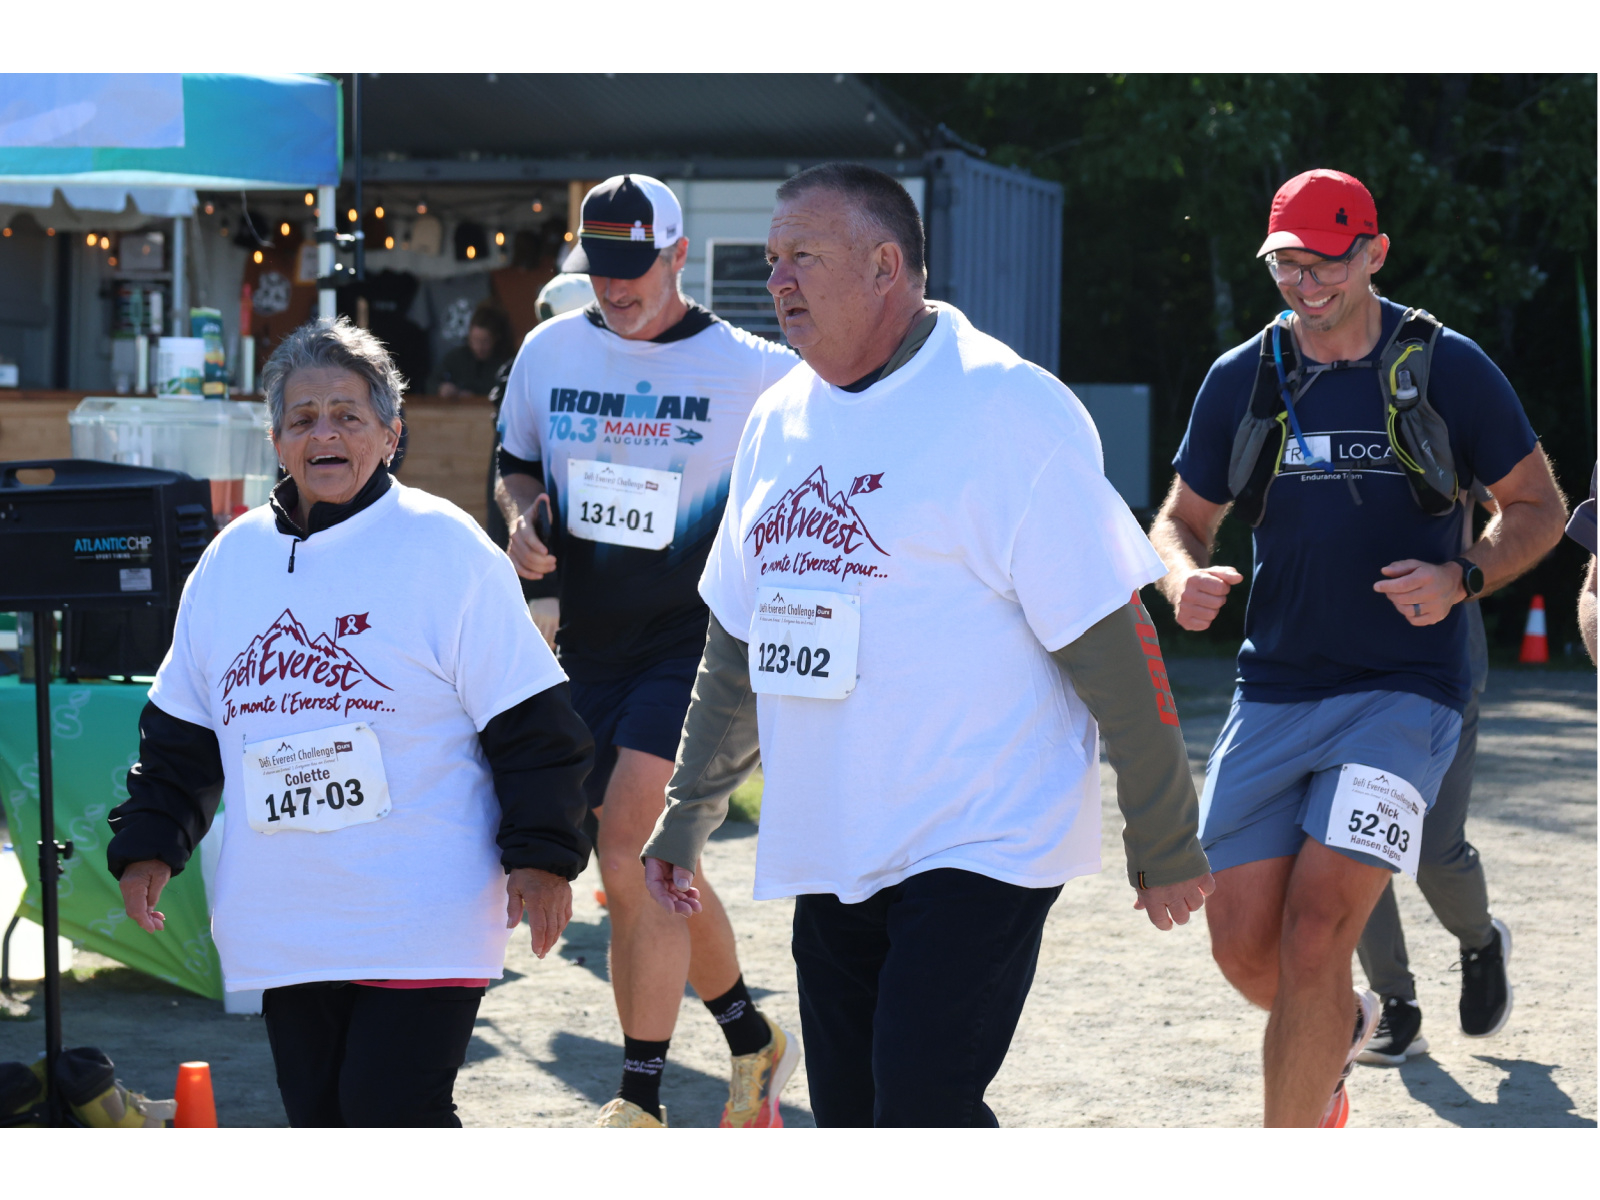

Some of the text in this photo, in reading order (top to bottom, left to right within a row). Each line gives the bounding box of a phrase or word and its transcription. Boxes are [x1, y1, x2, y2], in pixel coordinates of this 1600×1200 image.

[550, 382, 710, 422] IRONMAN
[549, 415, 672, 443] 70.3 MAINE
[604, 436, 669, 446] AUGUSTA
[617, 477, 644, 490] Challenge
[1301, 473, 1342, 482] Endurance
[580, 501, 654, 534] 131-01
[753, 488, 864, 557] Défi Everest
[793, 551, 843, 576] l'Everest
[842, 561, 888, 582] pour...
[787, 604, 815, 619] Challenge
[221, 632, 363, 702] Défi Everest
[758, 642, 831, 678] 123-02
[223, 691, 396, 726] Je monte l'Everest pour...
[258, 747, 335, 769] Défi Everest Challenge
[285, 768, 330, 787] Colette
[1352, 777, 1366, 788] Défi
[1367, 781, 1390, 795] Everest
[1390, 788, 1413, 809] Challenge
[265, 778, 365, 822] 147-03
[1376, 801, 1399, 820] Nick
[1348, 809, 1410, 853] 52-03
[1350, 834, 1401, 861] Hansen Signs
